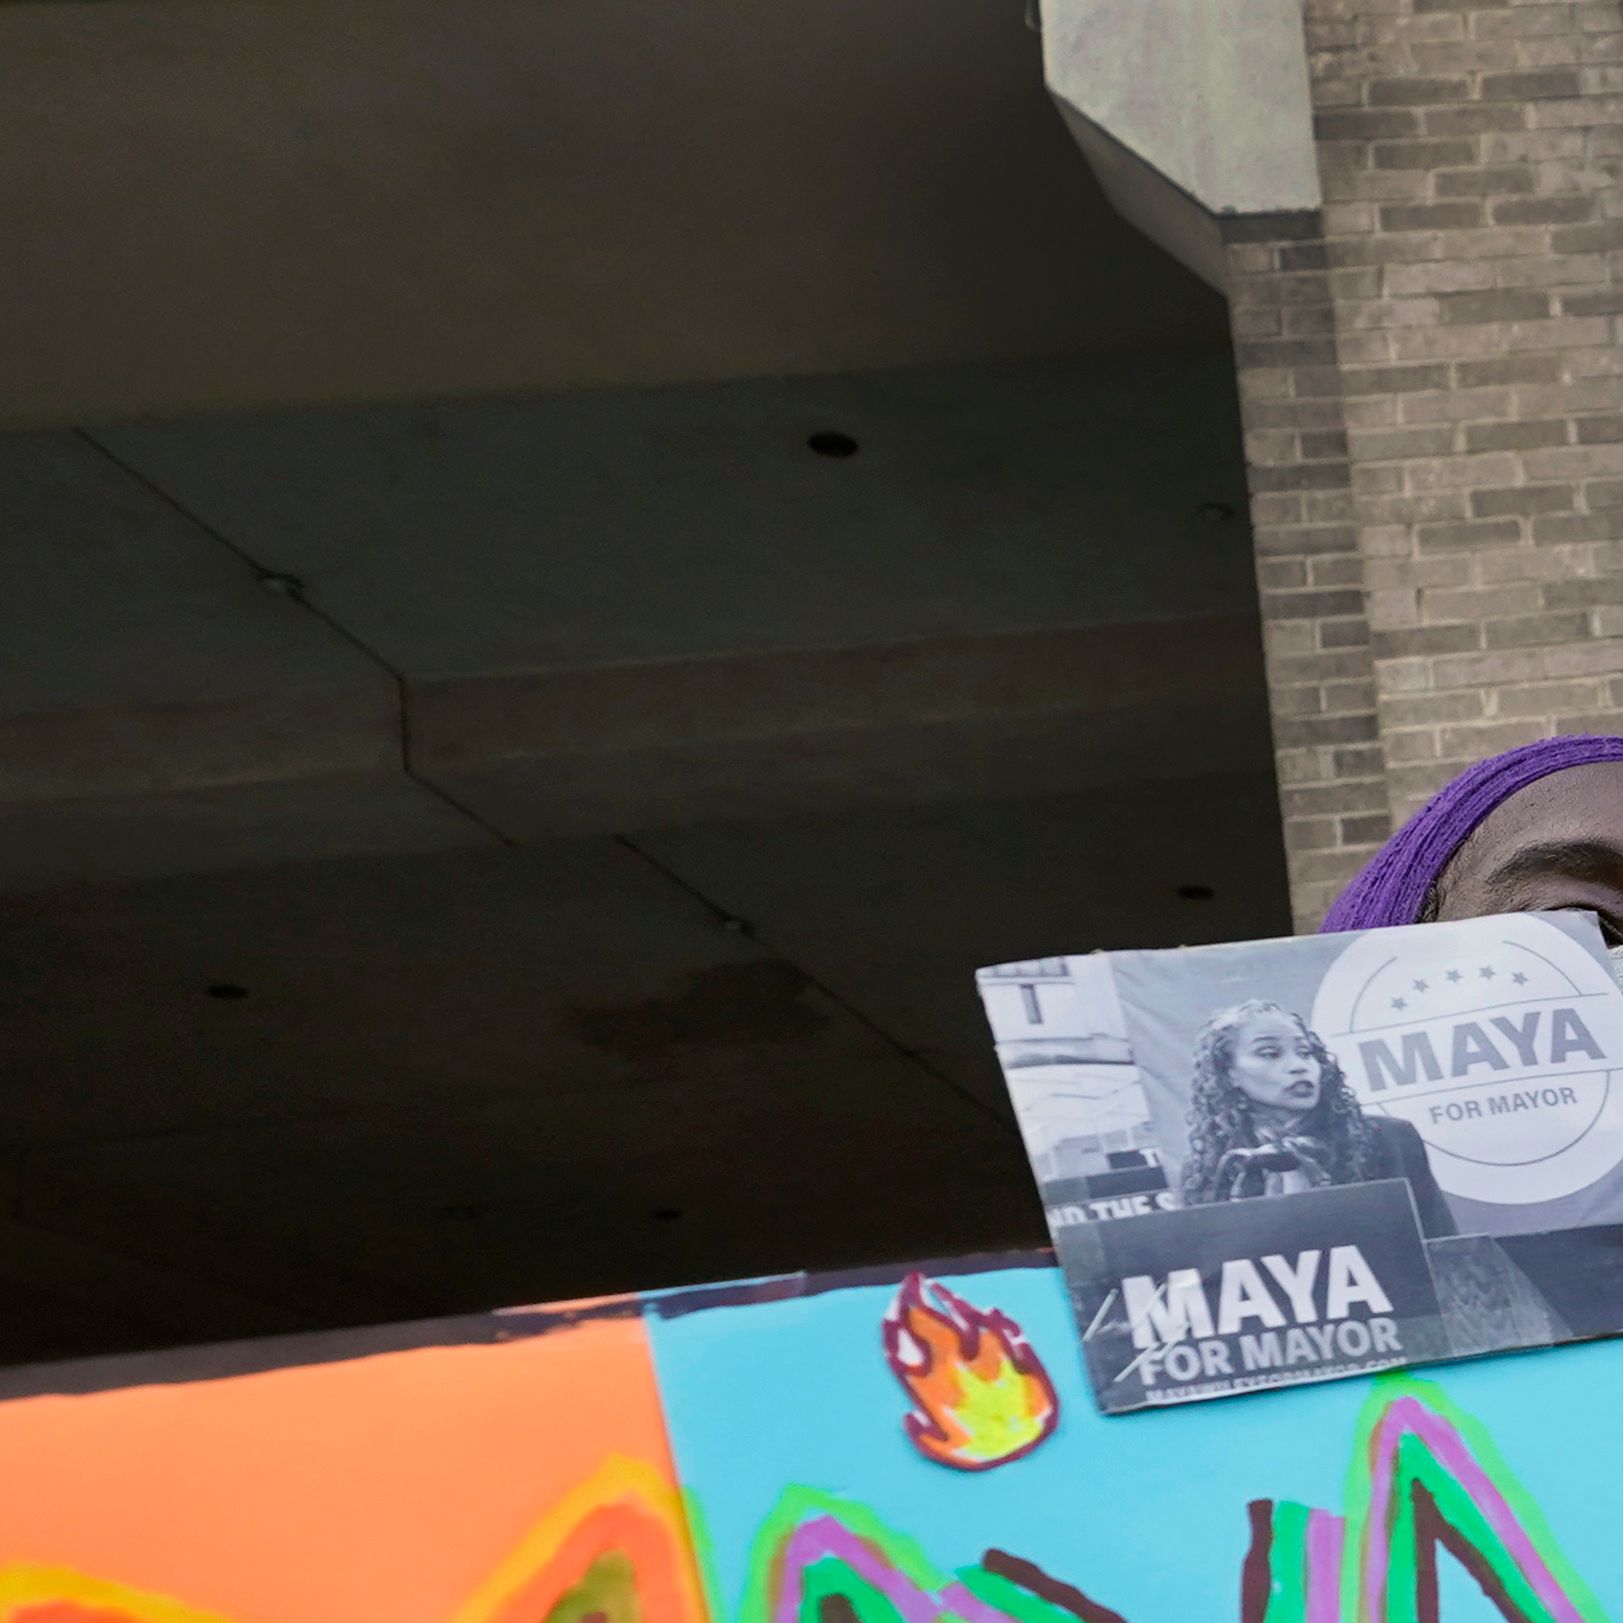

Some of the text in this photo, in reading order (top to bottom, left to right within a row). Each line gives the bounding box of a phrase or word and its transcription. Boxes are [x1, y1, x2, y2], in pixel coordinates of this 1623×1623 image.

[1358, 1008, 1607, 1092] MAYA
[1429, 1086, 1578, 1125] FOR MAYOR
[1121, 1244, 1394, 1349] MAYA
[1137, 1317, 1403, 1386] FOR MAYOR
